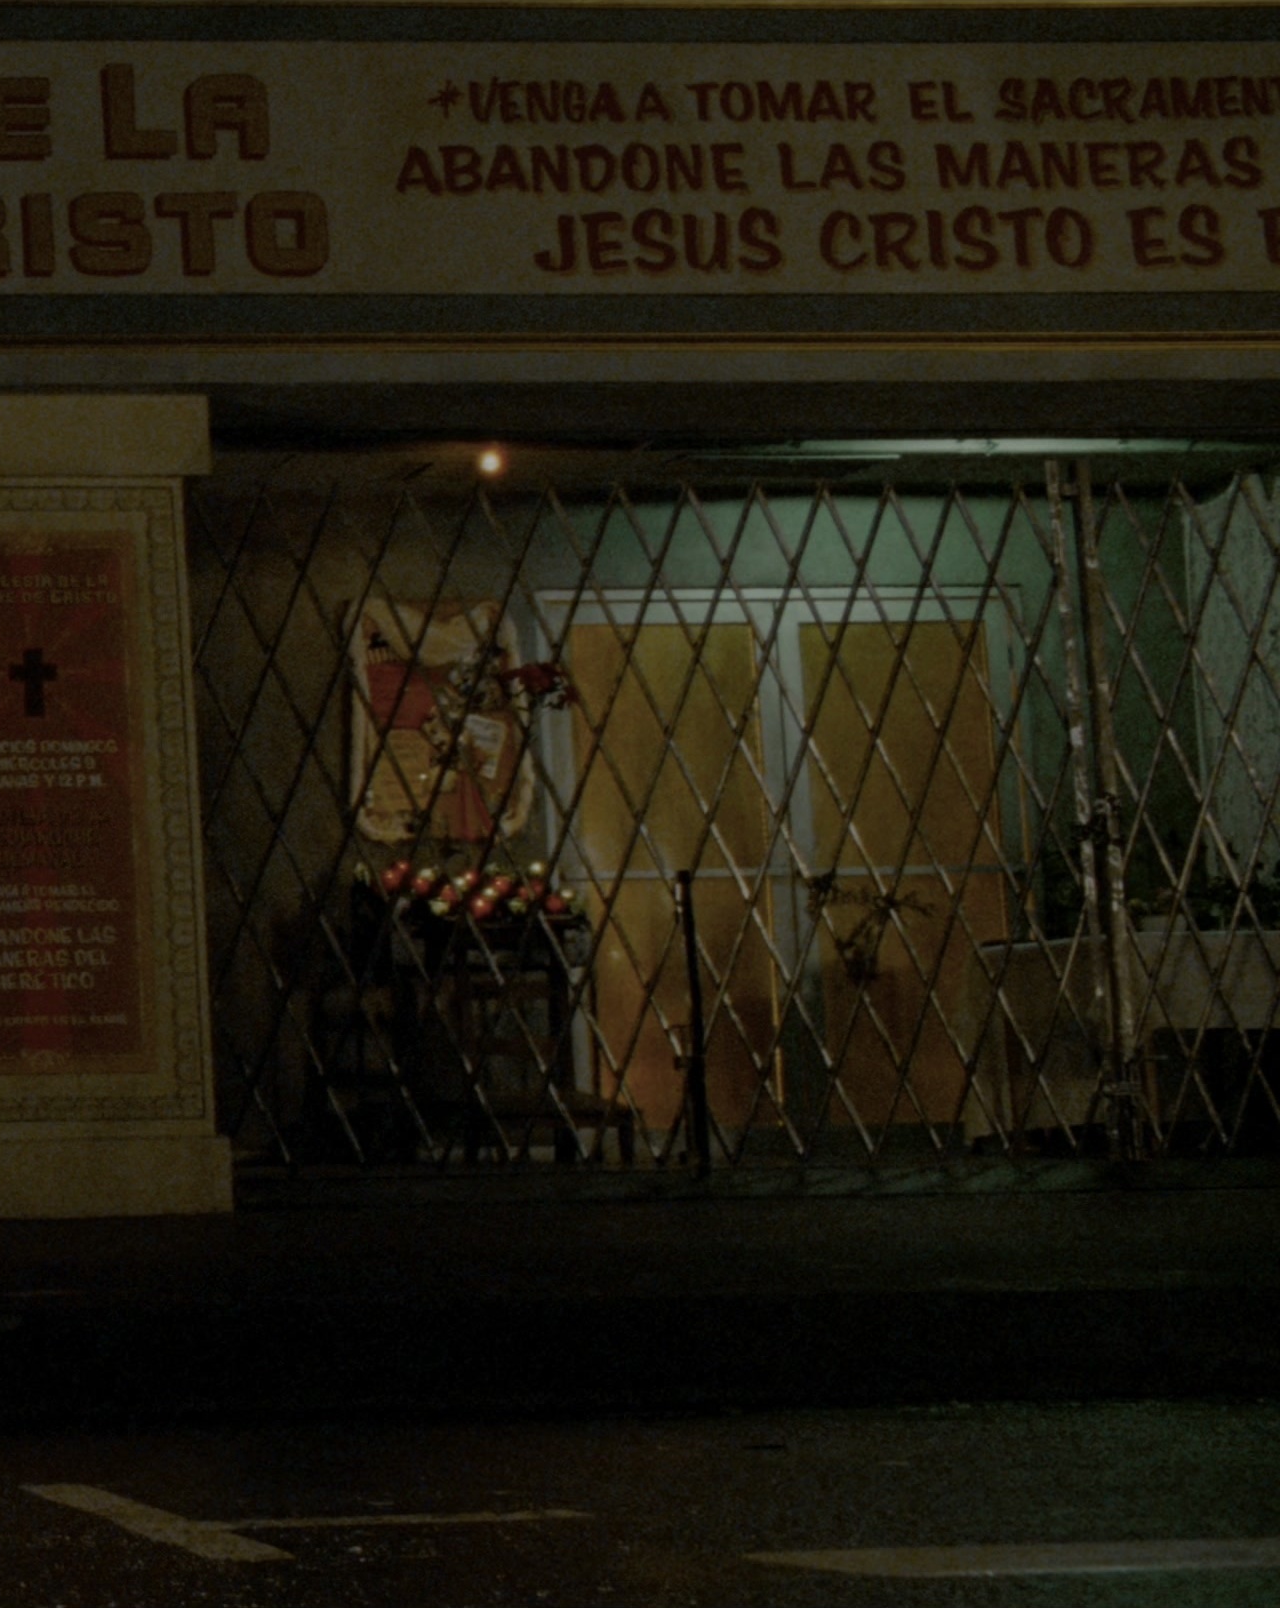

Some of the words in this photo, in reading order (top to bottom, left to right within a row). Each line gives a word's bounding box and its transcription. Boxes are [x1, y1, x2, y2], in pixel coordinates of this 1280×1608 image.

[100, 63, 270, 160] LA
[468, 80, 626, 123] VENGA
[635, 84, 672, 122] A
[692, 81, 874, 122] TOMAR
[909, 81, 972, 123] EL
[397, 144, 742, 196] ABANDONE
[779, 141, 906, 193] LAS
[936, 137, 1262, 189] MANERAS
[535, 208, 782, 274] JESUS
[820, 206, 1093, 272] CRISTO
[1129, 205, 1224, 268] ES
[74, 949, 110, 967] DEL
[76, 925, 118, 945] LAS
